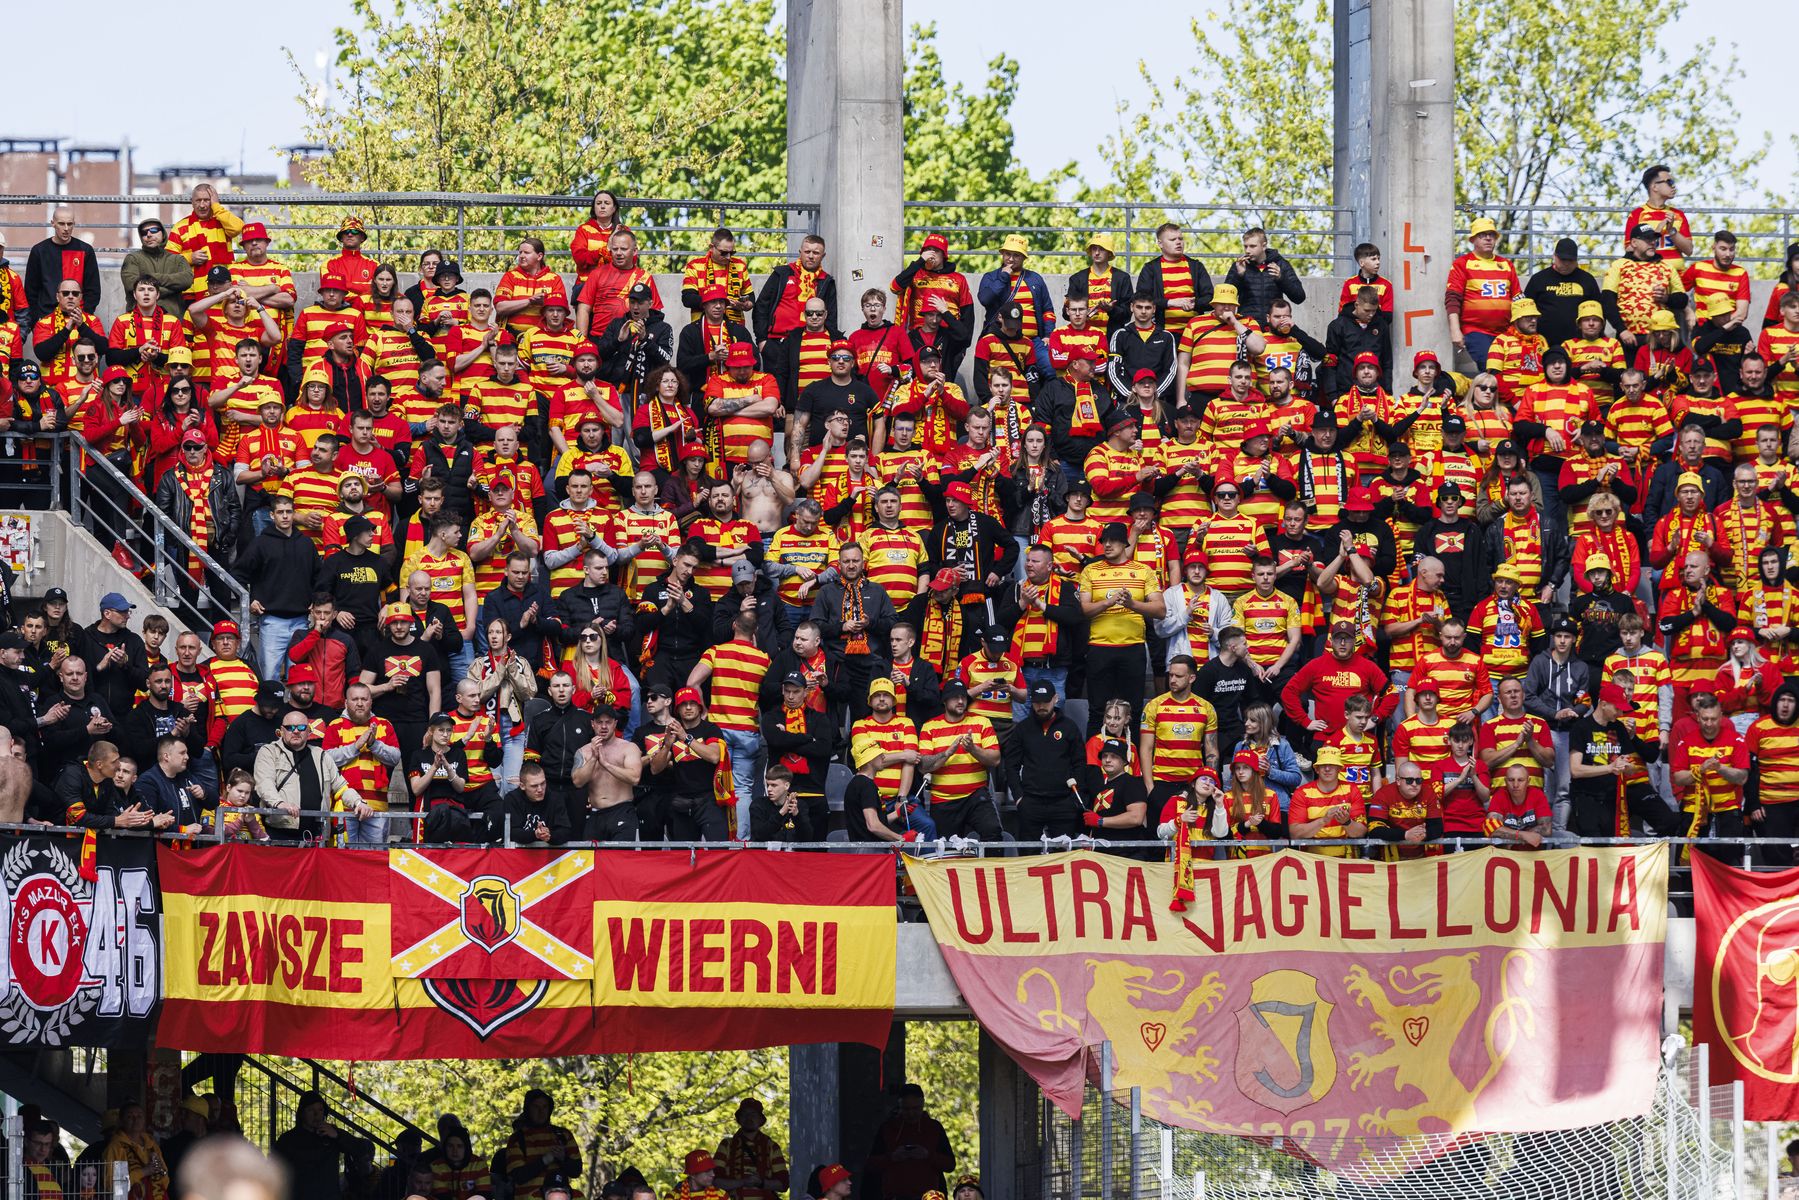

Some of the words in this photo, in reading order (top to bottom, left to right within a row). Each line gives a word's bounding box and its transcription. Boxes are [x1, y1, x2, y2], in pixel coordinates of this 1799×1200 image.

[1482, 280, 1506, 298] STS
[1265, 352, 1292, 371] STS
[17, 906, 30, 944] MKS
[27, 886, 68, 912] MAZUR
[68, 911, 81, 947] EŁK
[946, 859, 1158, 945] ULTRA
[1182, 855, 1640, 953] JAGIELLONIA
[41, 919, 61, 966] K
[82, 866, 157, 1018] 46
[198, 910, 364, 993] ZAWSZE
[607, 917, 838, 995] WIERNI
